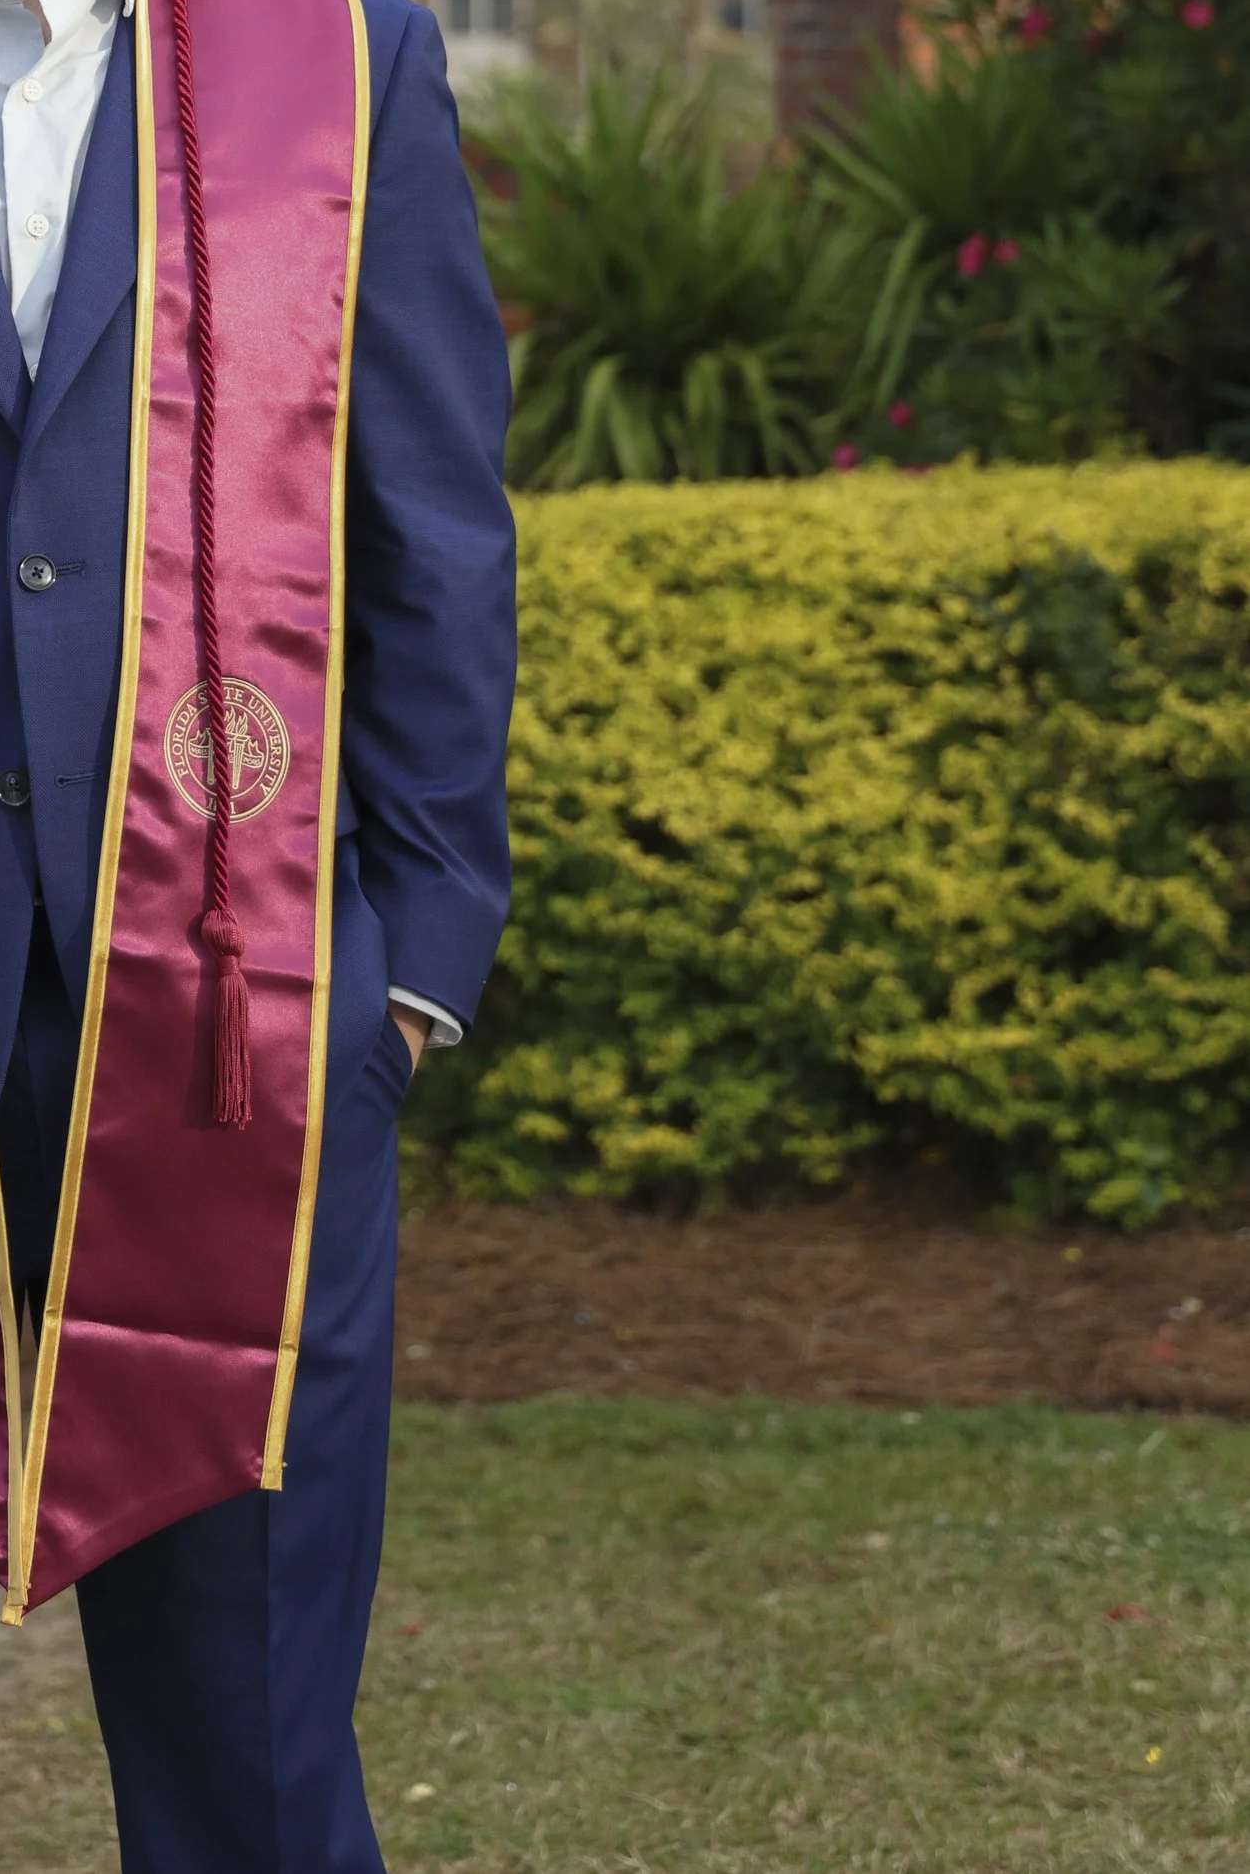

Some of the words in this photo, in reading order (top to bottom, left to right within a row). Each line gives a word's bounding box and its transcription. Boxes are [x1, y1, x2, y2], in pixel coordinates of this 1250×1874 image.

[172, 702, 198, 780] FLORIDA
[198, 686, 245, 704] STE
[248, 695, 282, 797] UNIVERSITY
